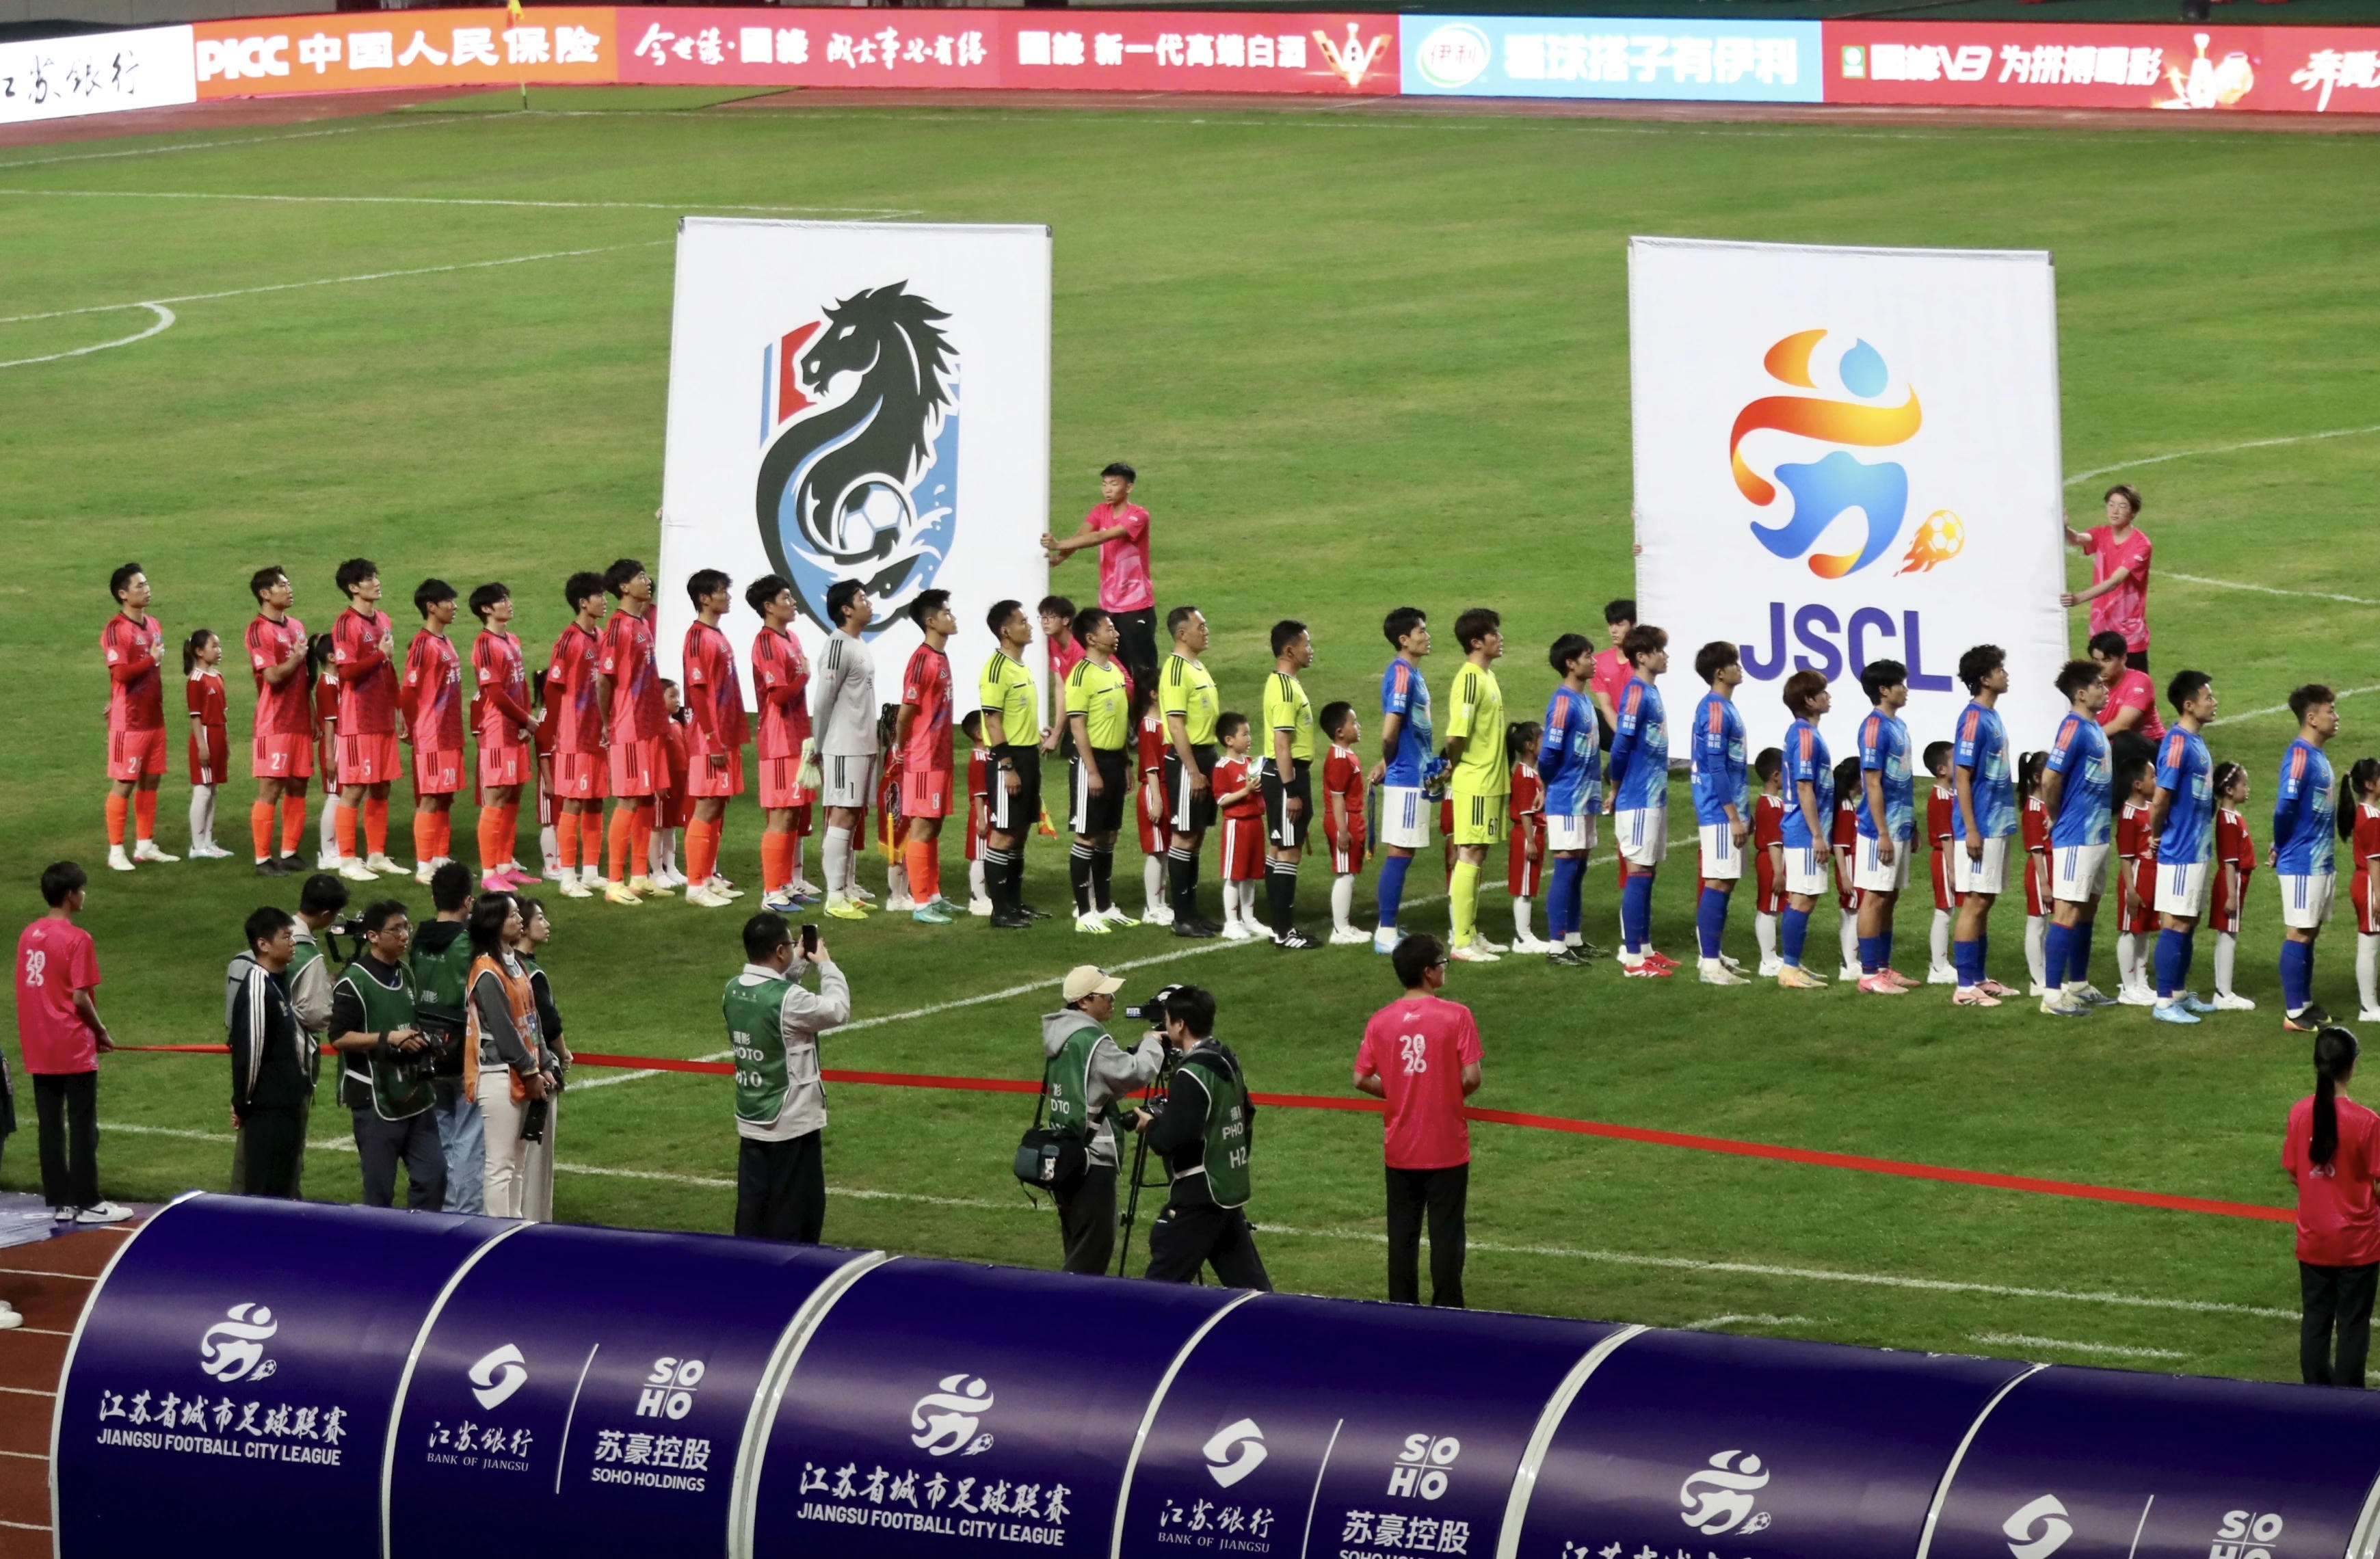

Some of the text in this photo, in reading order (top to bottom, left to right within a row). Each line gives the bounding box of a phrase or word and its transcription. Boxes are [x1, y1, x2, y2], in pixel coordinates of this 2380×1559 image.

[198, 25, 602, 81] PICC 中国人民保险
[1094, 32, 1306, 68] 新一代高端白酒
[1431, 44, 1477, 65] 伊利
[2290, 49, 2380, 112] 奔腾
[1739, 602, 1953, 692] JSCL
[271, 753, 288, 770] 27
[365, 759, 371, 777] 5
[580, 774, 587, 791] 6
[722, 772, 729, 789] 3
[732, 1045, 765, 1062] HOTO
[1050, 1098, 1070, 1115] OTO
[1222, 1122, 1243, 1140] PHO
[98, 1389, 348, 1445] 江苏省城市足球联赛
[97, 1428, 341, 1466] JIANGSU FOOTBALL CITY LEAGUE
[428, 1420, 533, 1458] 江苏银行
[594, 1430, 711, 1472] 苏豪控股
[427, 1452, 529, 1472] BANK OF JIANGSU
[591, 1468, 706, 1492] SOHO HOLDINGS
[799, 1462, 1072, 1525] 江苏省城市足球联赛
[797, 1503, 1066, 1547] JIANGSU FOOTBALL CITY LEAGUE
[1160, 1498, 1275, 1539] 江苏银行
[1342, 1510, 1470, 1556] 苏豪控股
[1158, 1532, 1270, 1554] BANK OF JIANGSU
